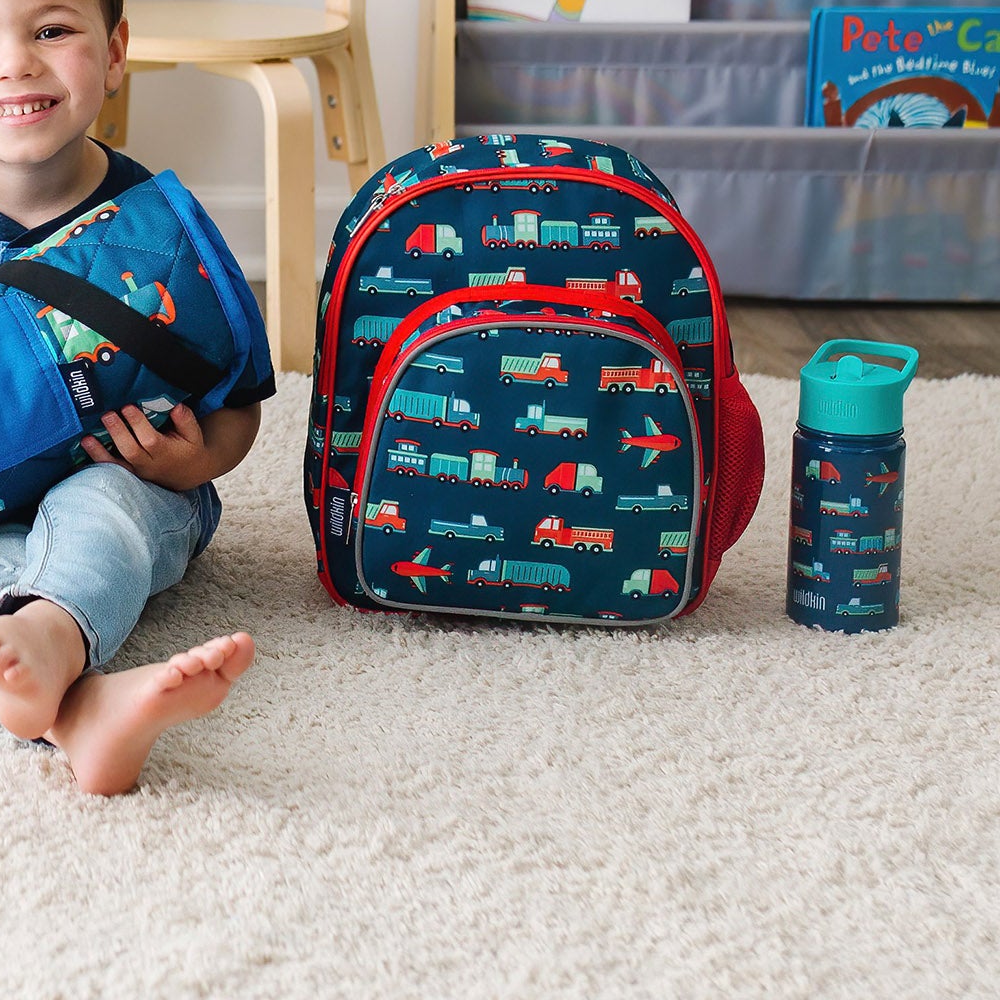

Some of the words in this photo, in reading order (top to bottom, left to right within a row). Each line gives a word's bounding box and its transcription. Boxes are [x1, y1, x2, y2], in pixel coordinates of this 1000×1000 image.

[842, 14, 924, 53] Pete
[956, 17, 1000, 53] Ca
[68, 370, 95, 409] wildkin
[330, 496, 345, 537] wildkin
[793, 588, 826, 611] wildkin
